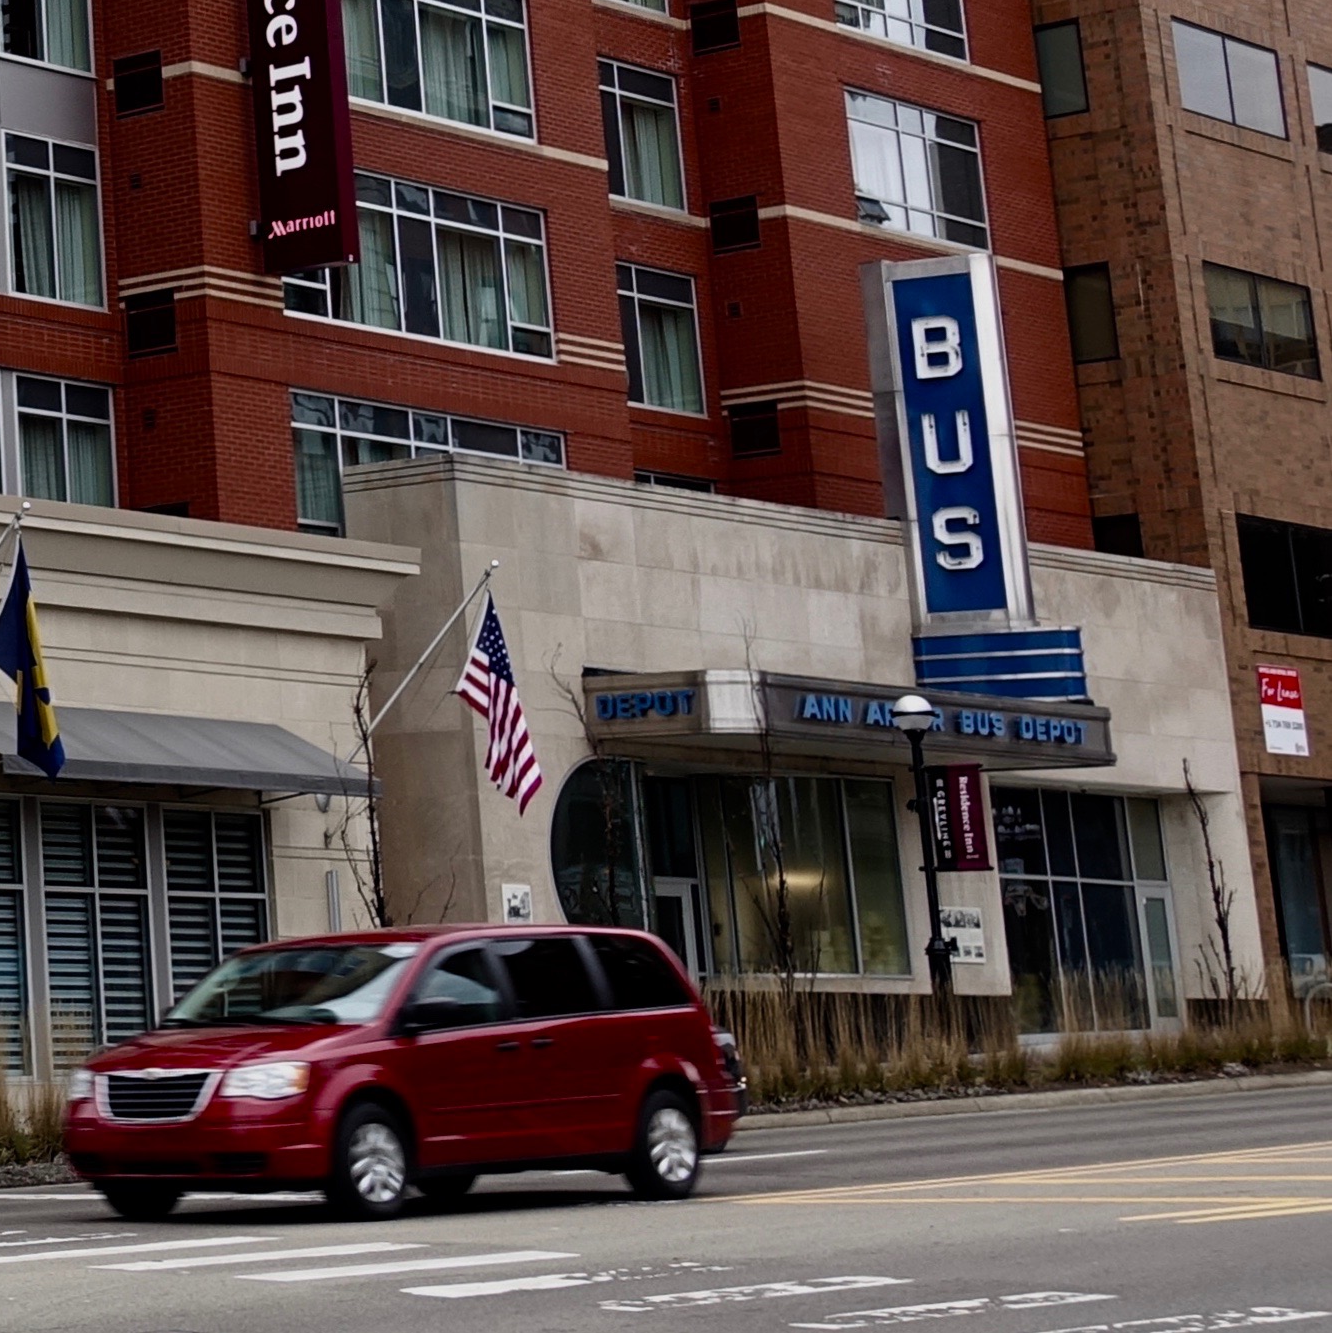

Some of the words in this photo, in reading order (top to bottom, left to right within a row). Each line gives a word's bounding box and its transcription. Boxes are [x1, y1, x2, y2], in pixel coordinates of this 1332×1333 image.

[268, 55, 312, 177] Inn
[268, 209, 336, 239] Marriott
[911, 314, 984, 571] BUS
[595, 688, 694, 720] DEPOT
[802, 695, 852, 723] ANN
[866, 700, 945, 732] ARR
[959, 709, 1005, 736] BUS
[1019, 714, 1088, 746] DEPOT
